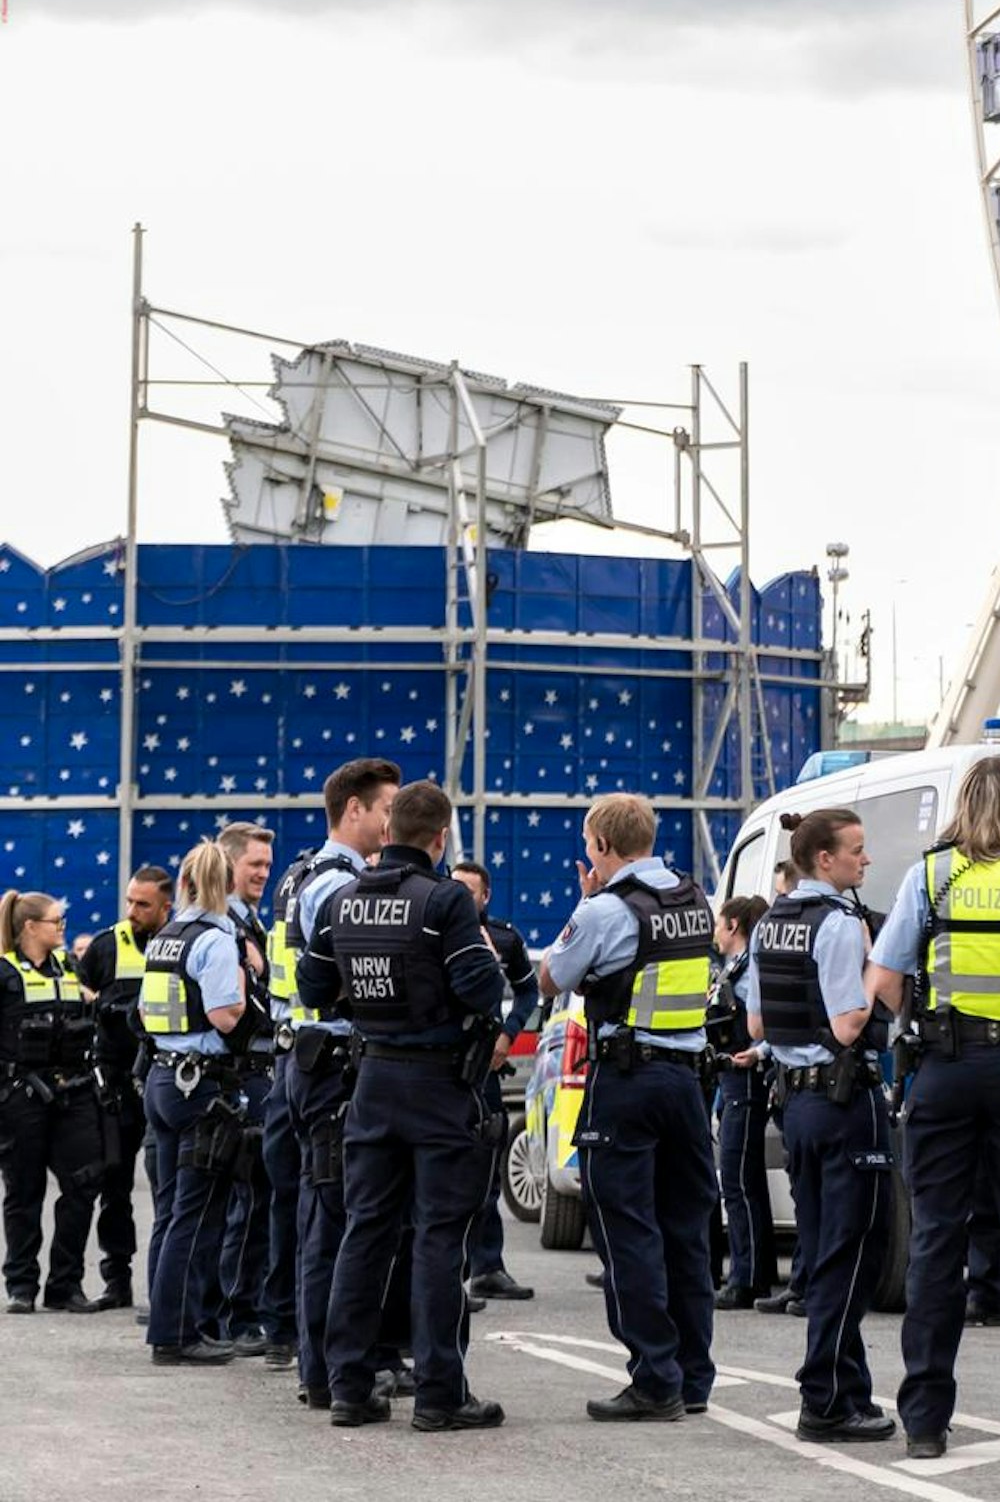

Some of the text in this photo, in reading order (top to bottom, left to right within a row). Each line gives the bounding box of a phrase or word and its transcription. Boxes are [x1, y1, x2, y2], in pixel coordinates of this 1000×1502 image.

[339, 898, 411, 925] POLIZEI
[650, 910, 711, 940] POLIZEI
[758, 922, 811, 952] POLIZEI
[351, 957, 391, 976] NRW
[352, 978, 395, 998] 31451
